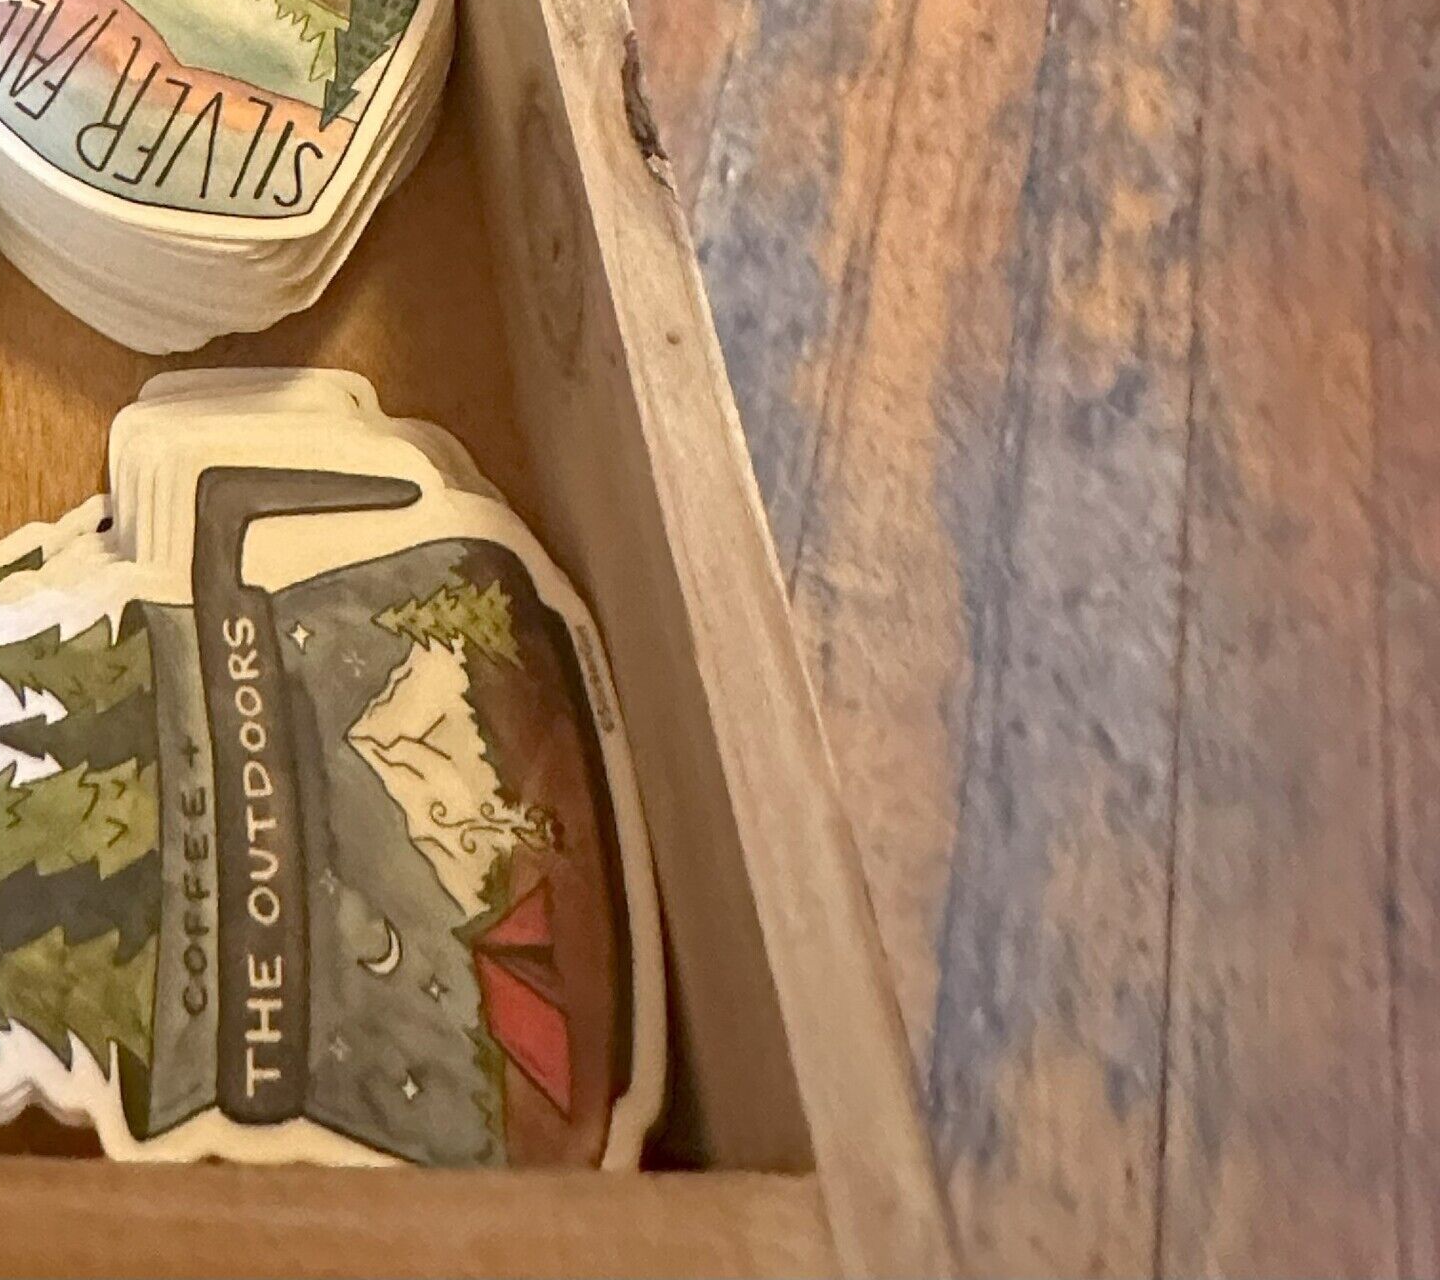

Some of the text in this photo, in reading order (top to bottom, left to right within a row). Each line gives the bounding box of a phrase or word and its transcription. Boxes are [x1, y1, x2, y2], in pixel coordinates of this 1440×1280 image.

[75, 33, 324, 208] SILVER
[181, 781, 211, 1017] COFFEE
[221, 614, 283, 1099] THE OUTDOORS
